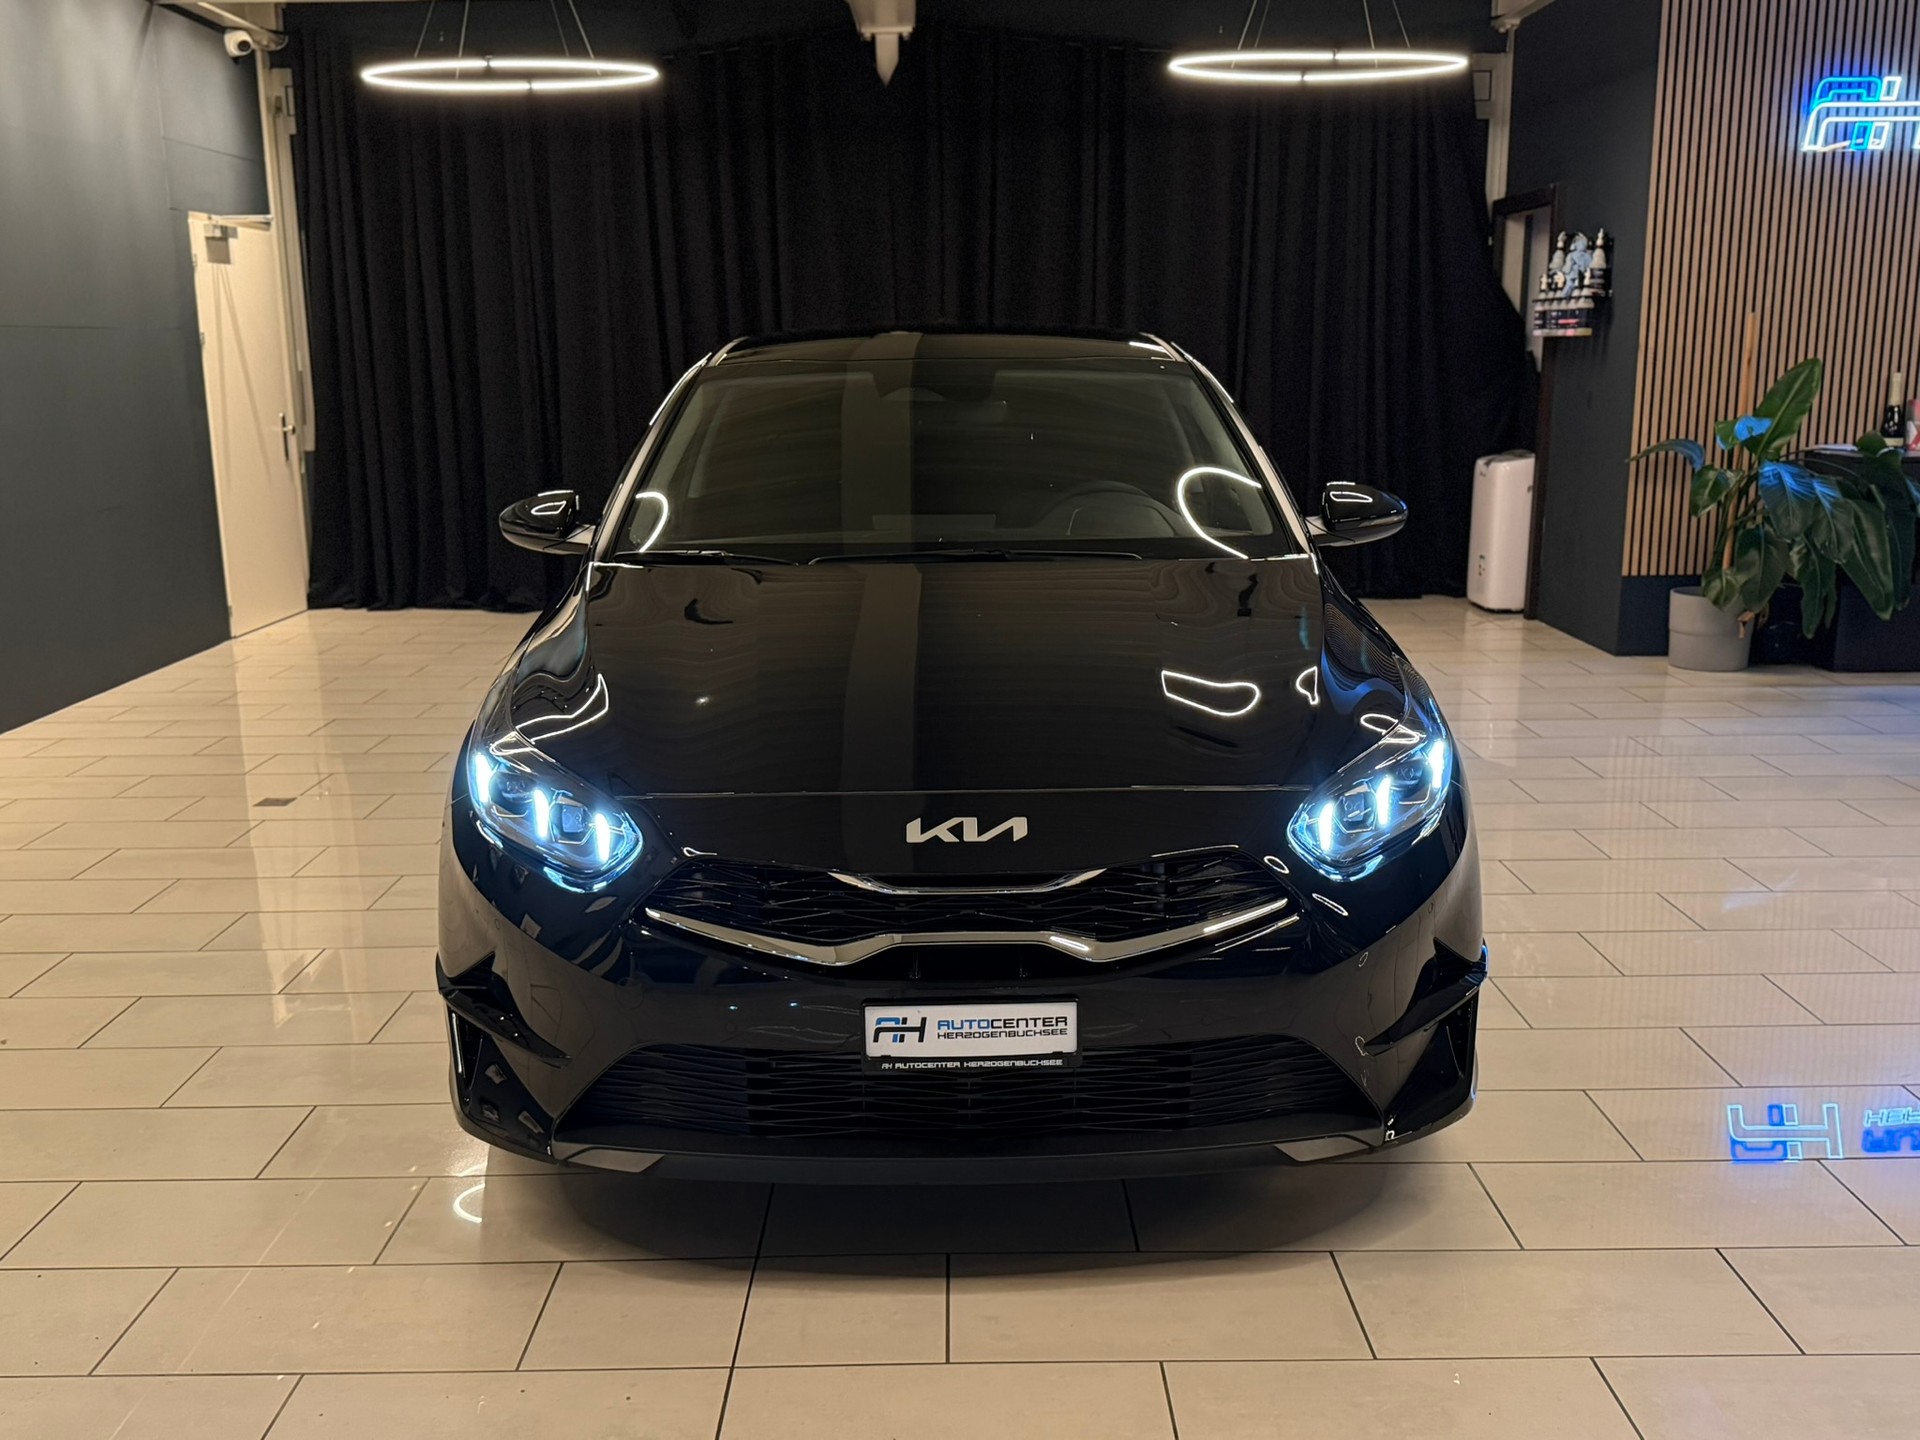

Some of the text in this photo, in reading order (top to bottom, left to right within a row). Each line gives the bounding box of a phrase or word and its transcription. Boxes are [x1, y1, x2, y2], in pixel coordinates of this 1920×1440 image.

[906, 816, 1028, 843] KIA
[937, 1016, 1068, 1030] AUTOCENTER
[937, 1028, 1068, 1039] HERZOGENBUCHSEE
[895, 1061, 961, 1069] AUTOCENTER
[964, 1059, 1063, 1068] HERZOGENBUCHSEE
